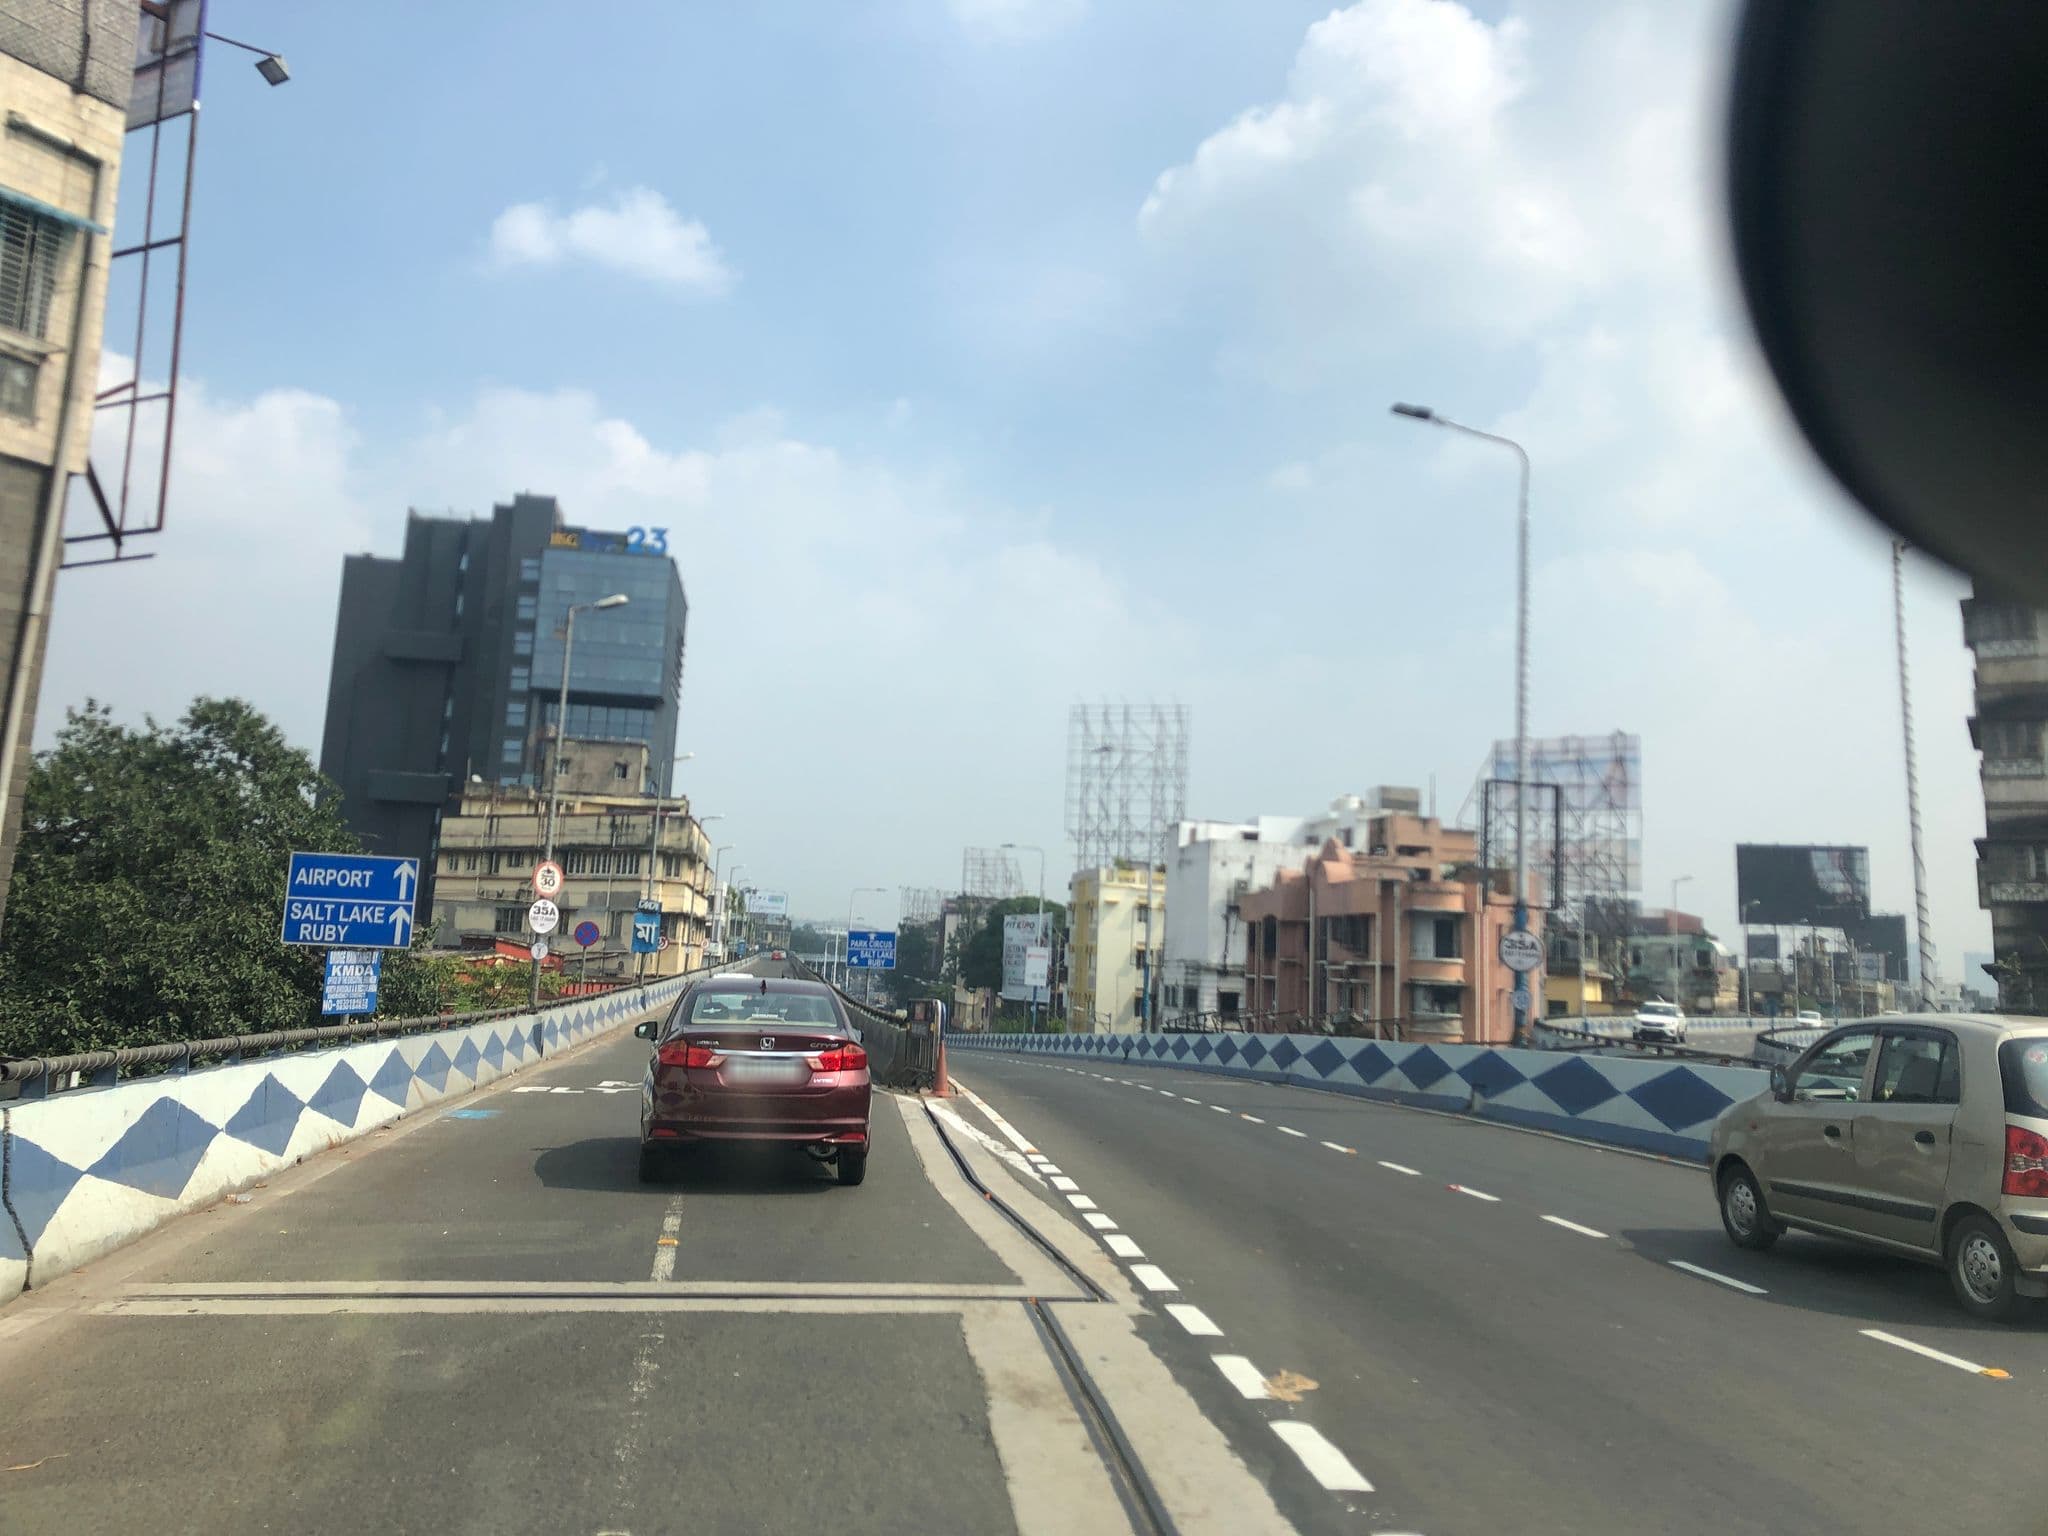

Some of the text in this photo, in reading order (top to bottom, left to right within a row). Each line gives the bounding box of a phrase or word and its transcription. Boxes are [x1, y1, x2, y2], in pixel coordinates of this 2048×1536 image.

[626, 526, 668, 555] 23
[295, 867, 374, 888] AIRPORT
[541, 878, 555, 887] 30
[290, 902, 386, 924] SALT LAKE
[533, 905, 556, 916] 35A
[299, 923, 350, 943] RUBY
[635, 922, 658, 945] মা
[850, 939, 893, 948] PARK CIRCUS
[860, 949, 894, 959] SALT LAKE
[867, 958, 886, 968] RUBY
[331, 964, 374, 977] KMDA
